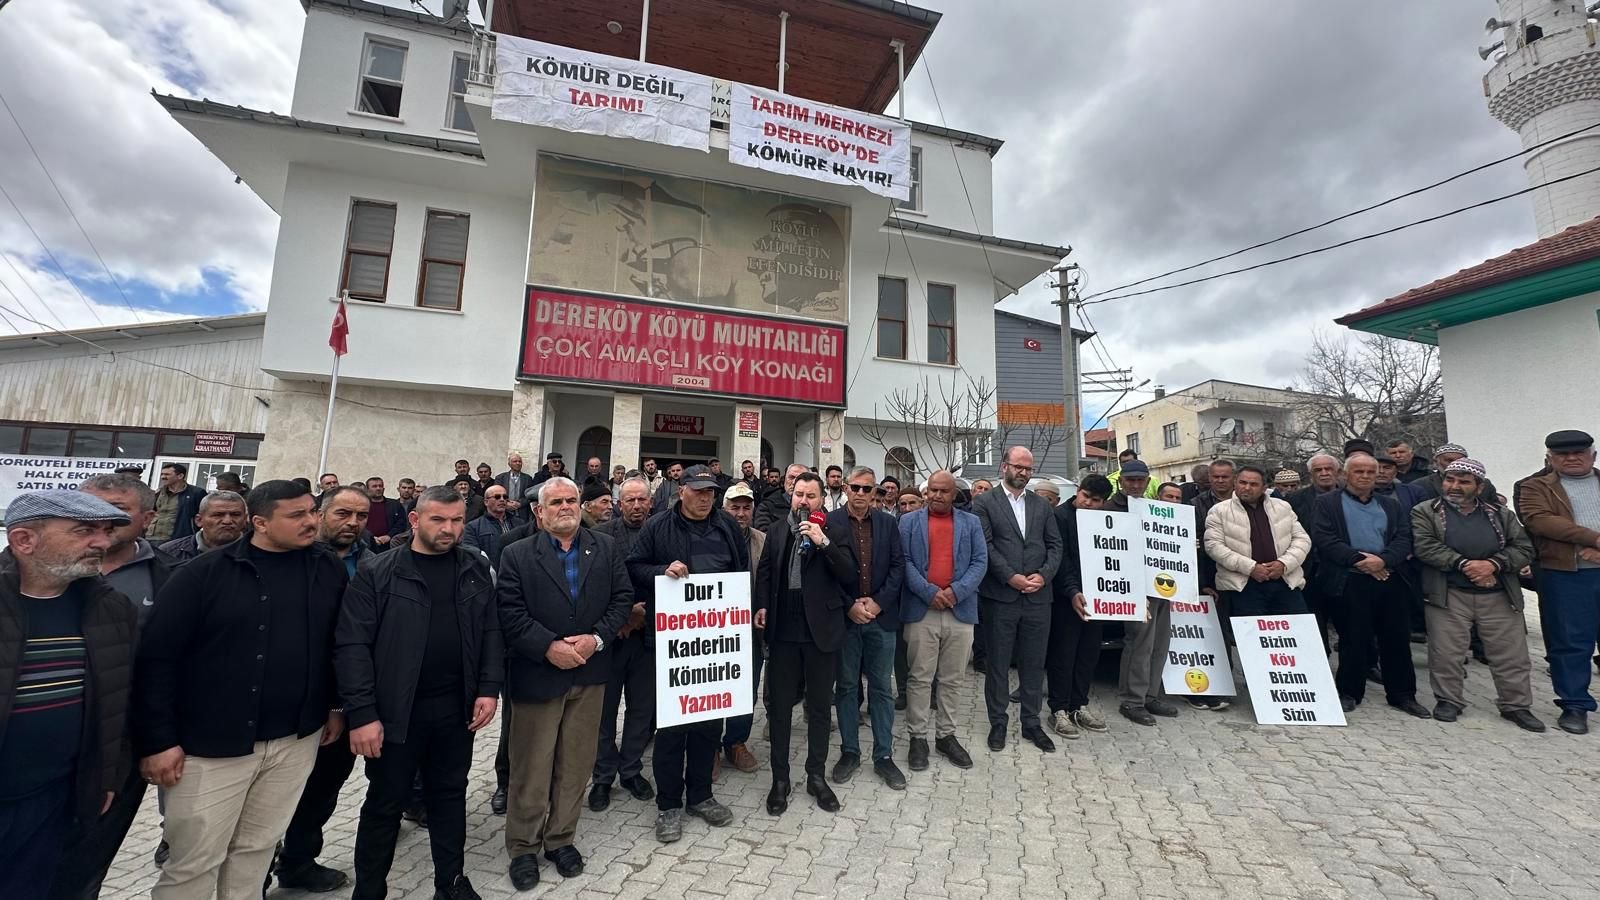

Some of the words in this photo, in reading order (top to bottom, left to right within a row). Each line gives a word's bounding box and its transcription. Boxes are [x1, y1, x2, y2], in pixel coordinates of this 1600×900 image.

[527, 56, 610, 86] KÖMÜR
[617, 74, 684, 101] DEĞİL,
[569, 88, 643, 113] TARIM!
[750, 96, 809, 123] TARIM
[815, 111, 892, 146] MERKEZİ
[764, 122, 880, 164] DEREKÖY'DE
[748, 141, 828, 172] KÖMÜRE
[833, 162, 892, 188] HAYIR!
[535, 298, 642, 334] DEREKÖY
[649, 310, 706, 342] KÖYÜ
[713, 322, 837, 357] MUHTARLIĞI
[535, 336, 592, 360] ÇOK
[598, 342, 690, 371] AMAÇLI
[697, 351, 745, 374] KÖY
[750, 361, 833, 384] KONAĞI
[676, 377, 706, 387] 2004
[24, 470, 64, 479] HALK
[1148, 503, 1175, 519] Yeşil
[1105, 515, 1113, 530] O
[1152, 521, 1175, 536] Arar
[1177, 525, 1189, 538] La
[1093, 535, 1128, 551] Kadın
[1146, 537, 1181, 554] Kömür
[1104, 556, 1120, 572] Bu
[1144, 554, 1190, 573] cağında
[684, 582, 714, 602] Dur
[1097, 576, 1131, 594] Ocağı
[1093, 598, 1136, 616] Kapatır
[656, 606, 750, 632] Dereköy'ün
[1257, 619, 1290, 631] Dere
[668, 633, 741, 659] Kaderini
[1259, 636, 1297, 648] Bizim
[1168, 650, 1215, 667] Beyler
[1269, 653, 1296, 667] Köy
[669, 661, 741, 688] Kömürle
[1269, 671, 1308, 684] Bizim
[679, 692, 732, 715] Yazma
[1270, 689, 1316, 703] Kömür
[1281, 708, 1317, 722] Sizin
